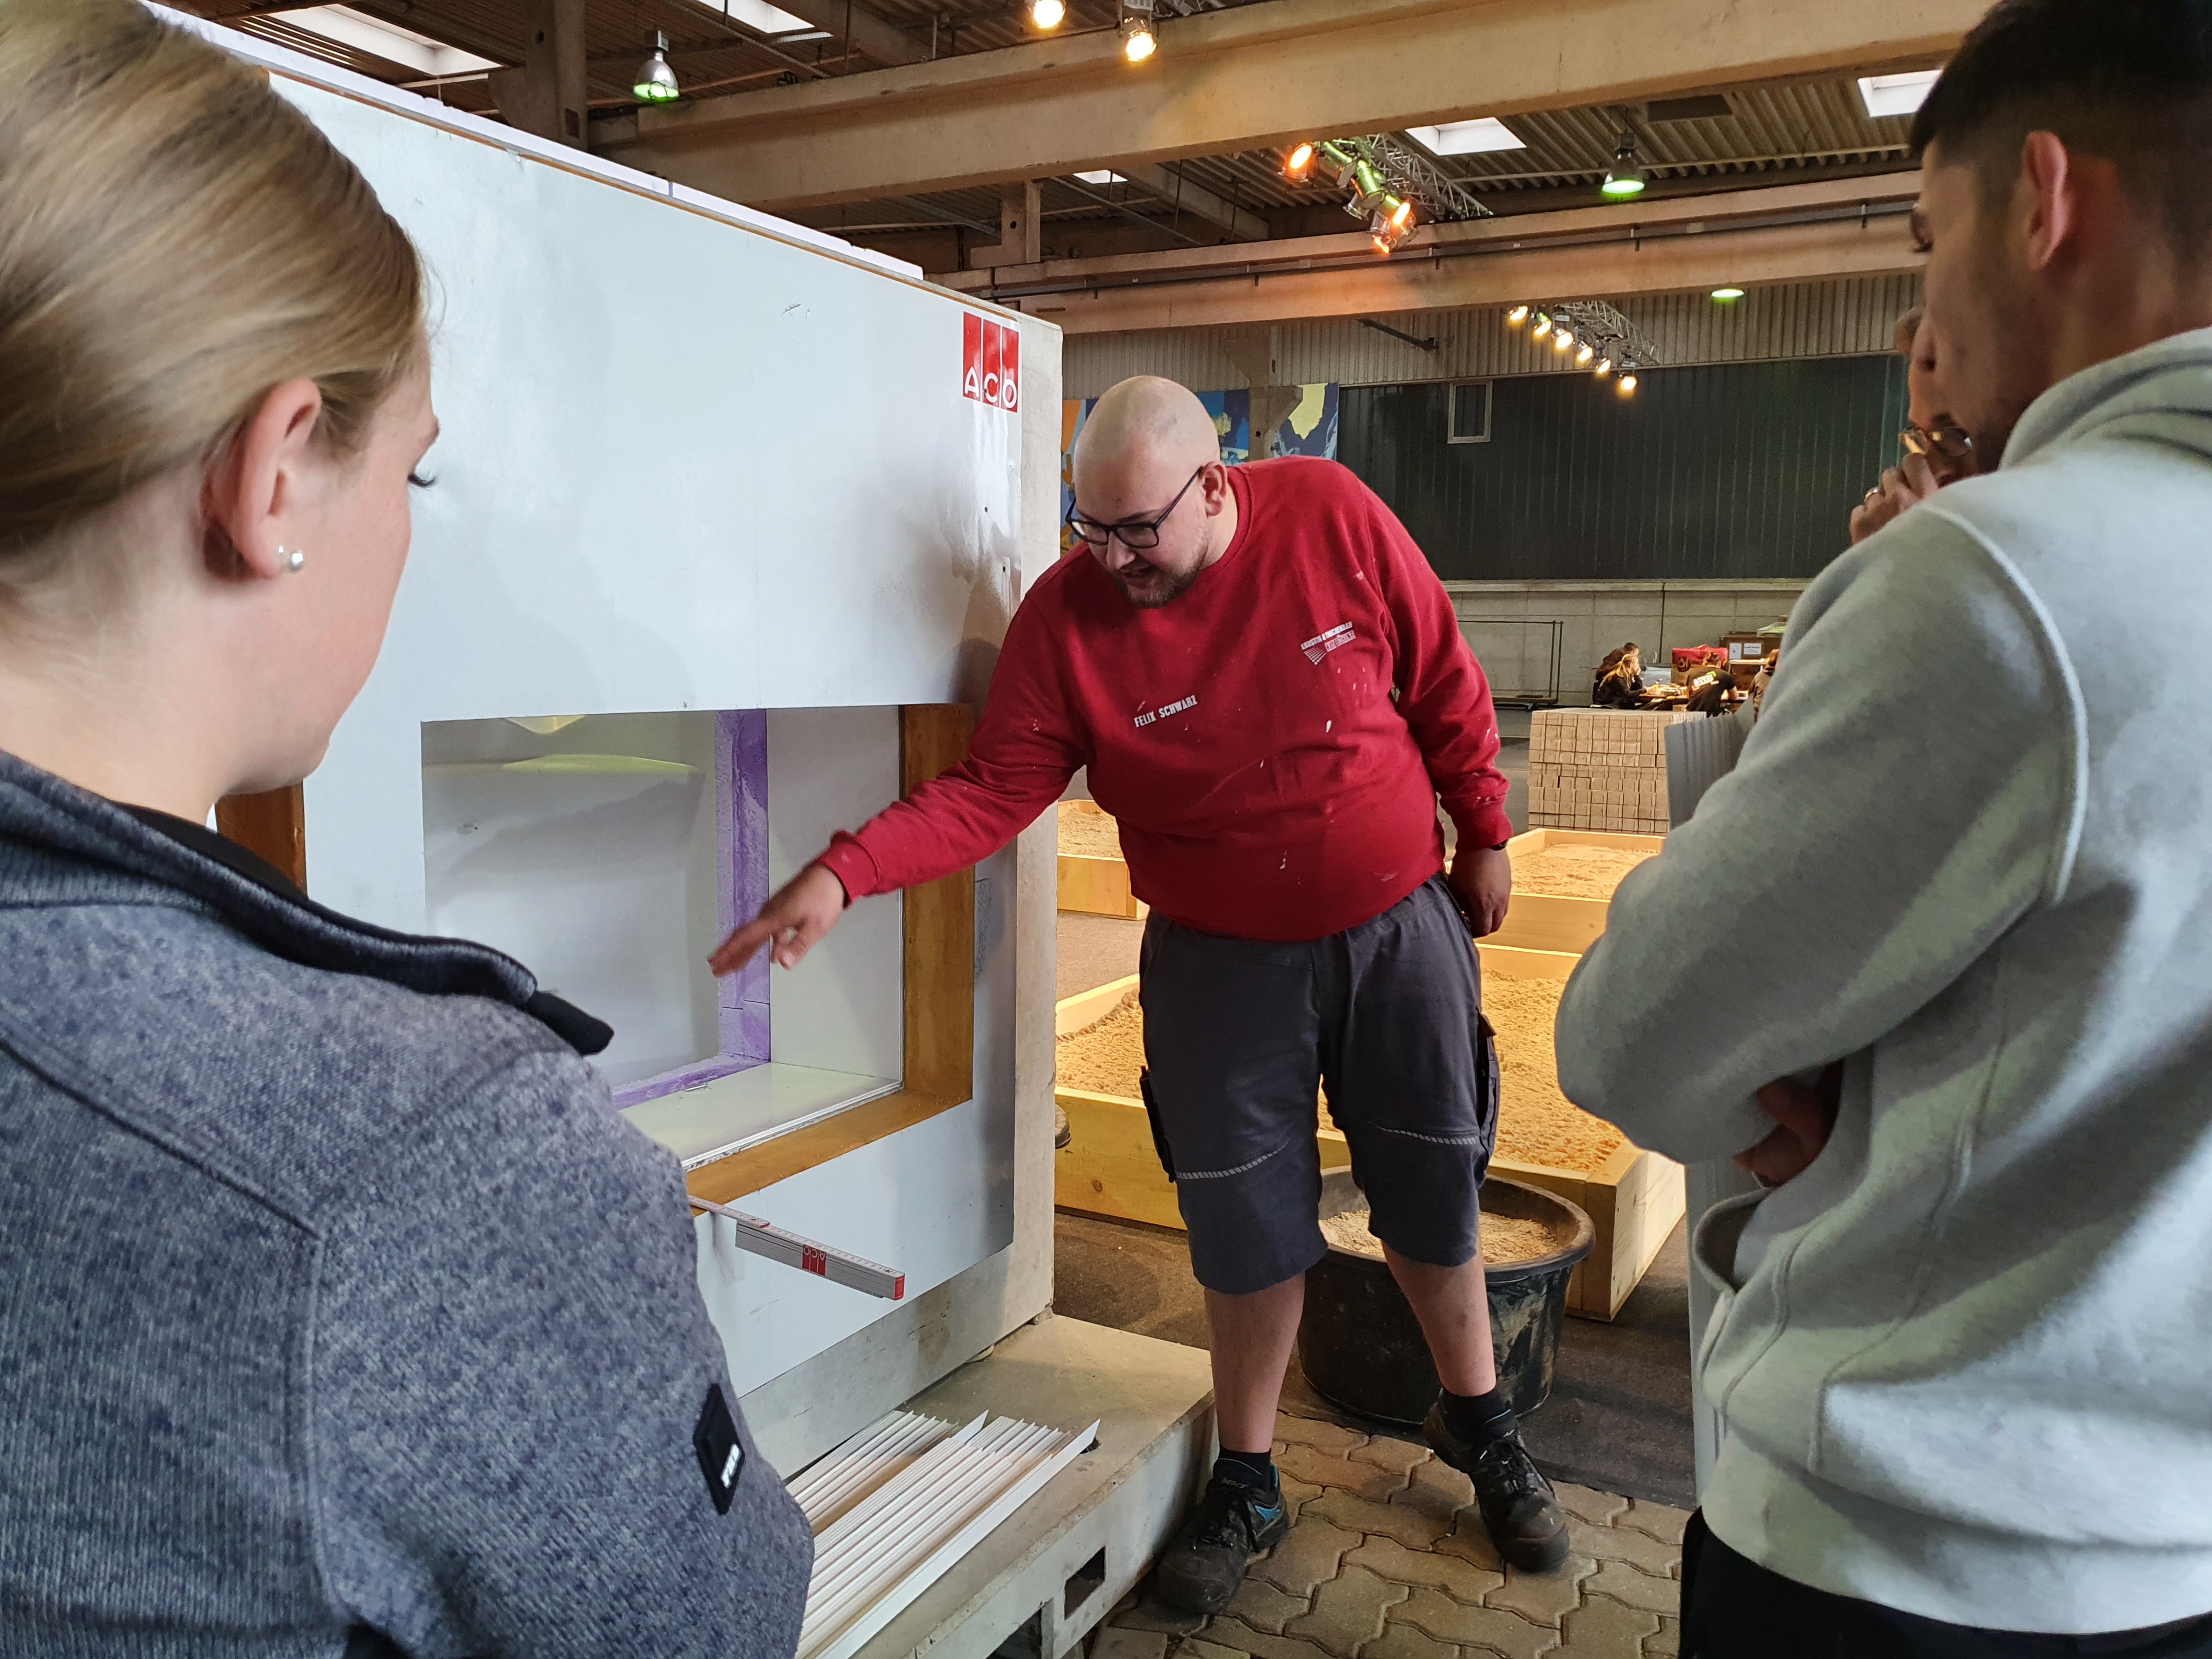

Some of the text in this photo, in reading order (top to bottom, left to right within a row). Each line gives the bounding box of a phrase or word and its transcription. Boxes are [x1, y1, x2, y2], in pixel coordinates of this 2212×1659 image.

[964, 366, 1017, 408] ACO
[1134, 695, 1198, 727] FELIX SCHWARZ
